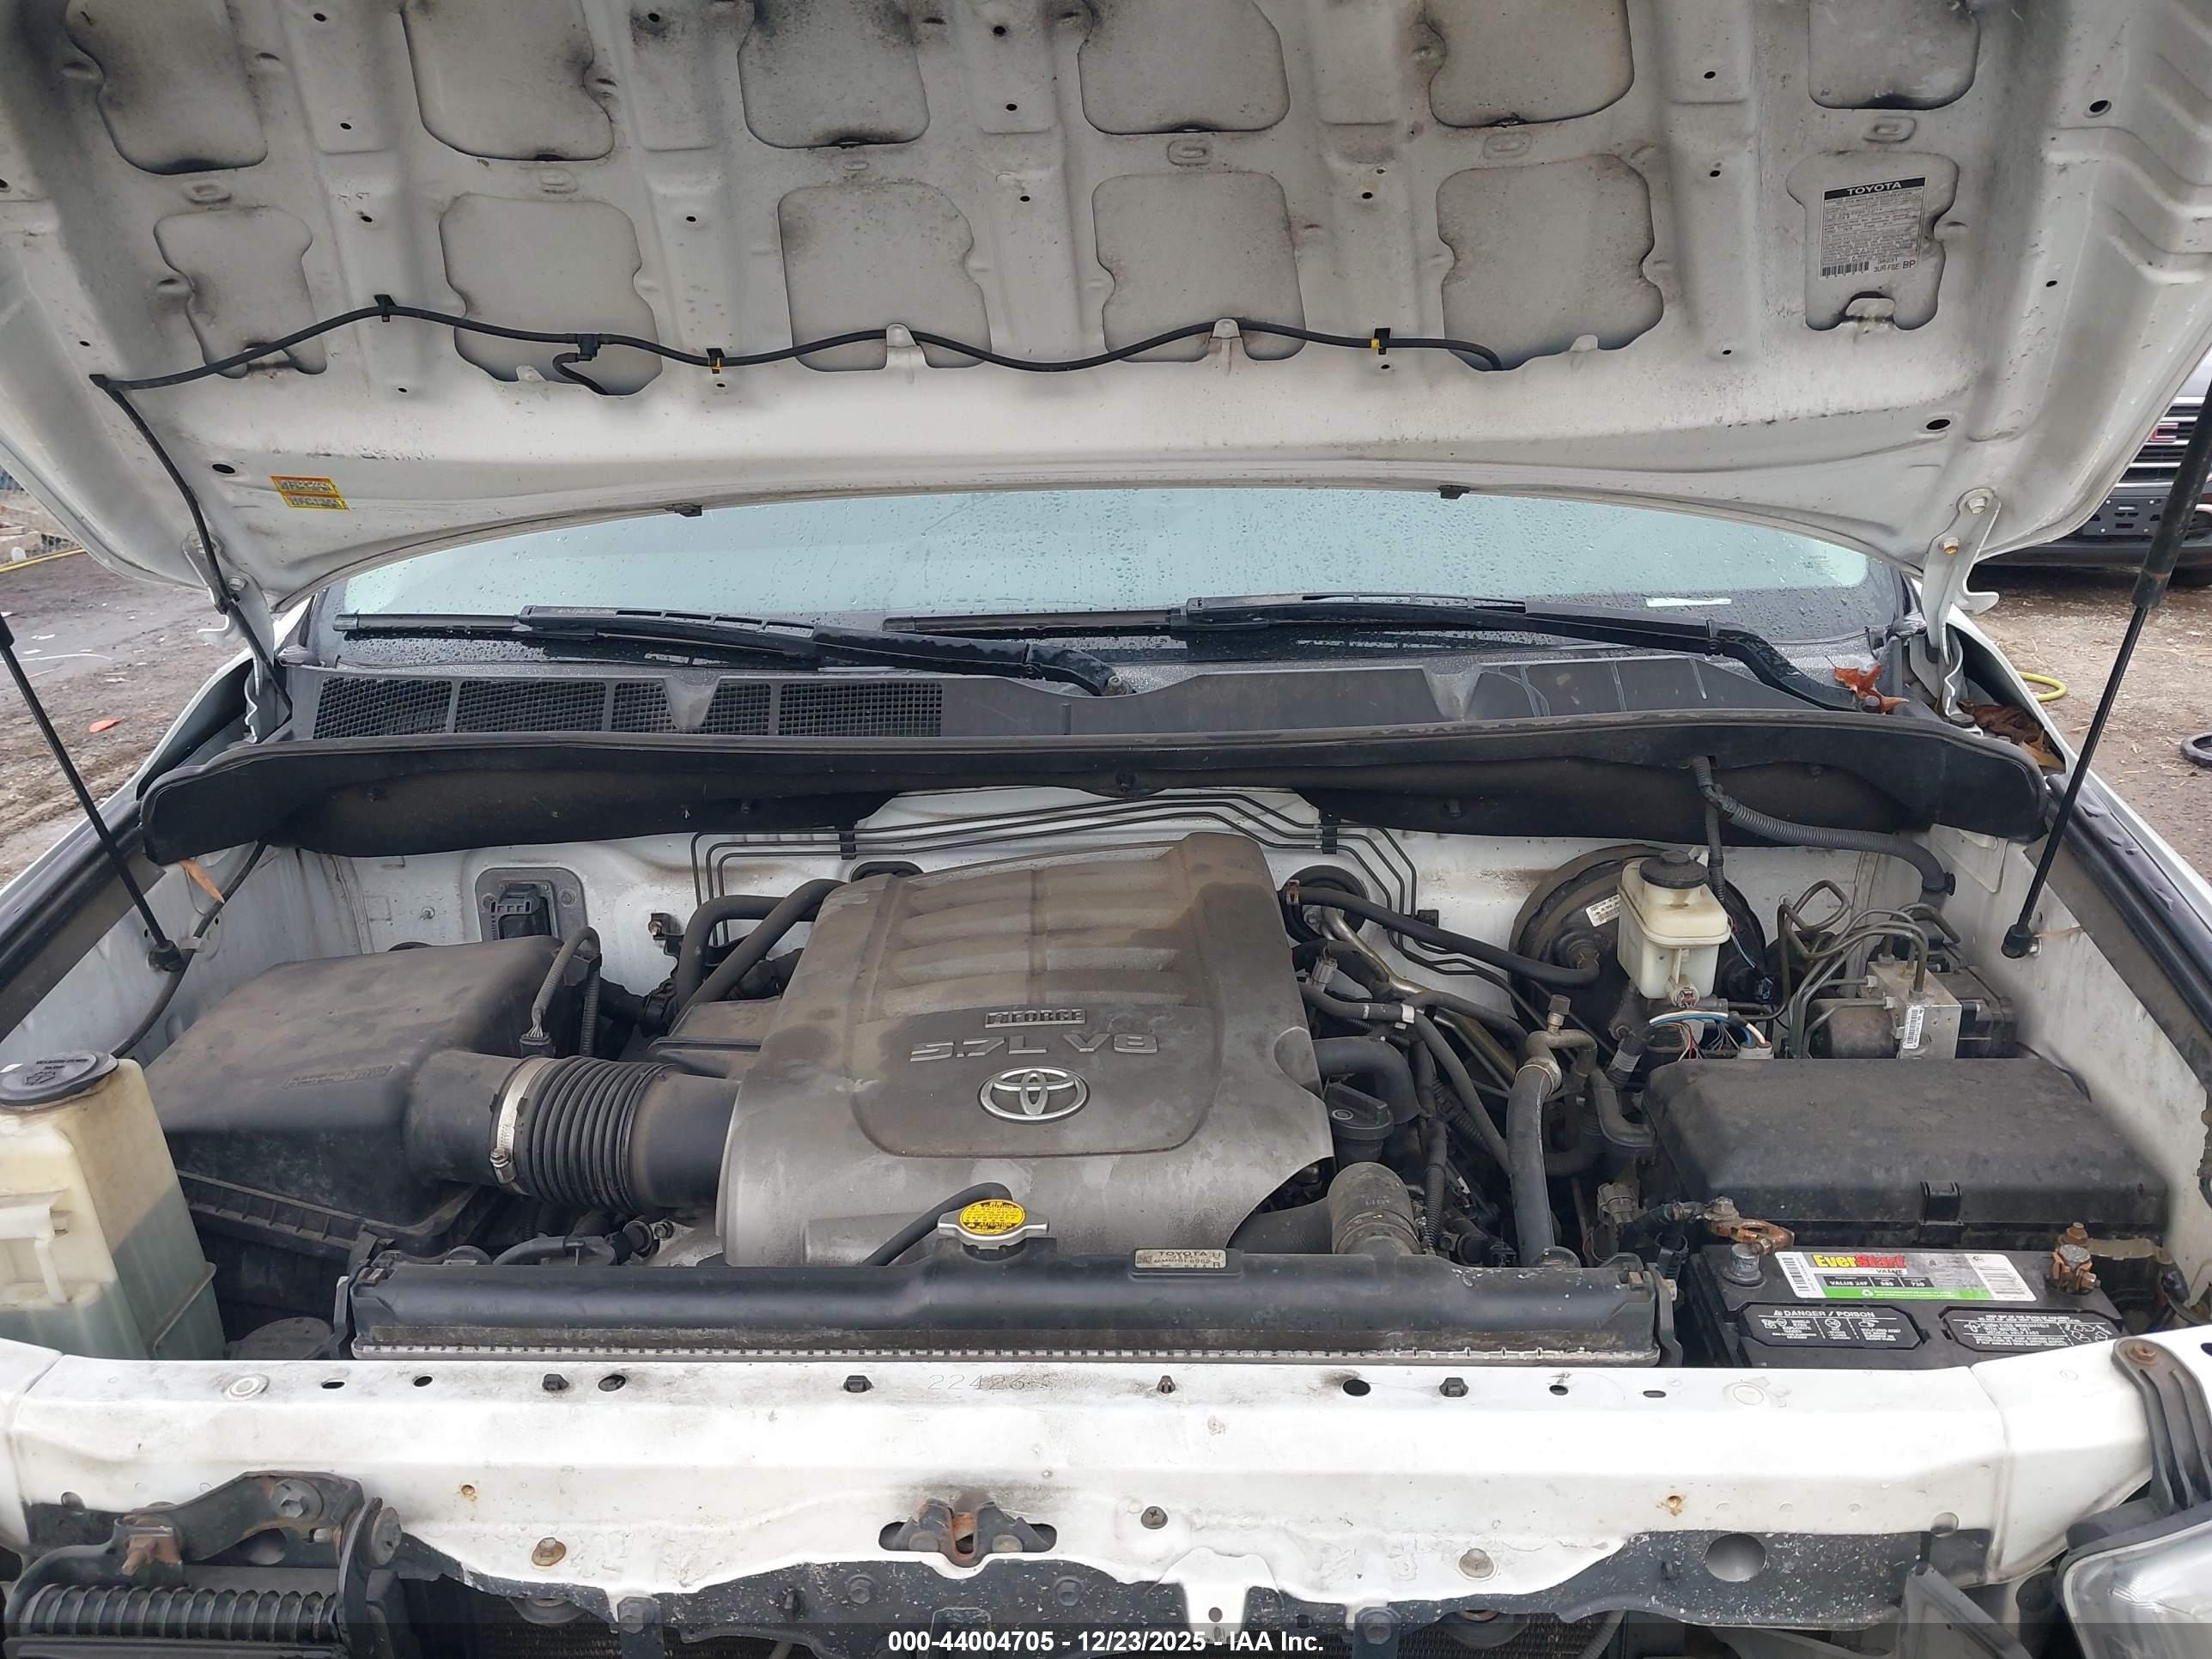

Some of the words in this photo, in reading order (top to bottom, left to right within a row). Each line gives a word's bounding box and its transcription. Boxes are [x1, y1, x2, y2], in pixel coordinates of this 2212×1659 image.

[1847, 181, 1902, 196] TOYOTA
[1902, 259, 1916, 270] BP
[909, 1036, 1048, 1062] 5.7L
[1063, 1032, 1158, 1054] V8
[1813, 1253, 1906, 1268] EverStart
